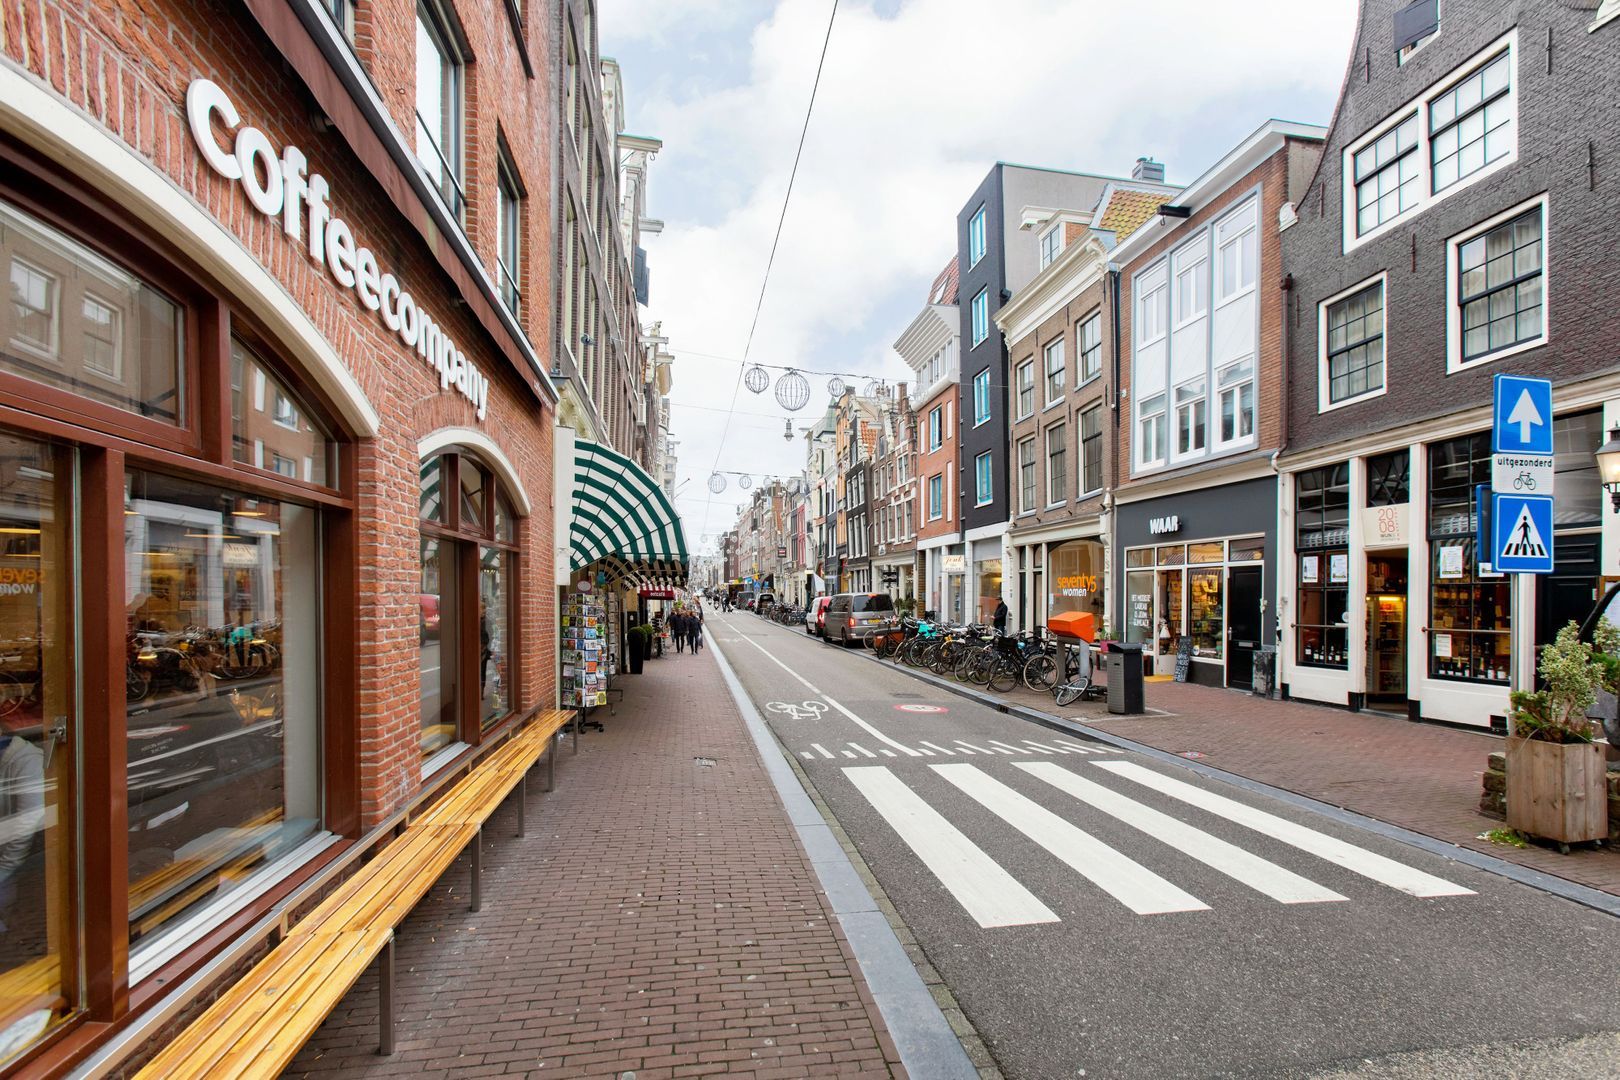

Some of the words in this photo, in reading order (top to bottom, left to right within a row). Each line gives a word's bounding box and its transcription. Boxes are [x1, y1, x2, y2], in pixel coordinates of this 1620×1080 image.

[1497, 456, 1553, 469] uitgezonderd
[1377, 507, 1394, 521] 20
[1150, 515, 1178, 534] WAAR
[1379, 520, 1396, 533] 08
[1057, 573, 1097, 593] seventy5
[1062, 588, 1087, 597] women
